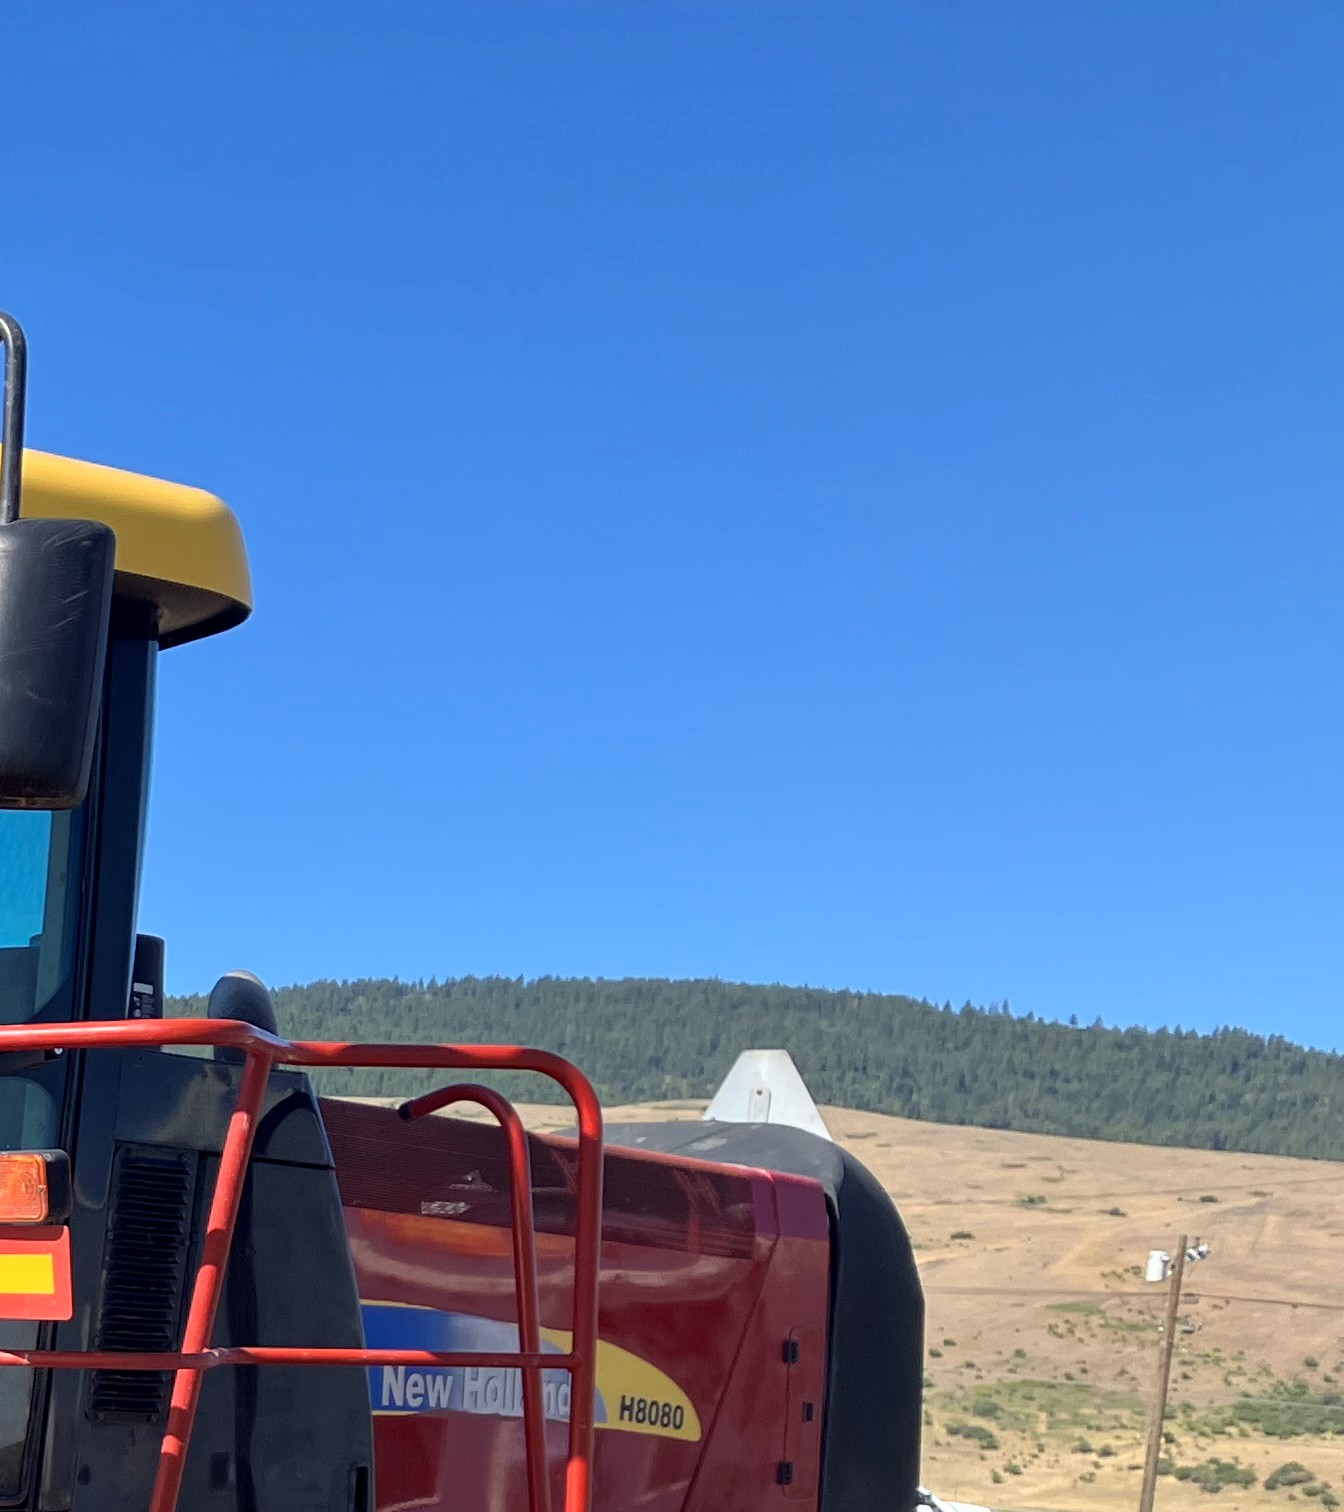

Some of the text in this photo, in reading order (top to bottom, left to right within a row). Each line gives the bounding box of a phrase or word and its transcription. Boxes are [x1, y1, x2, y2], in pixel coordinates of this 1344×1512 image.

[381, 1366, 572, 1416] New Hollnd
[618, 1394, 685, 1431] H8080
